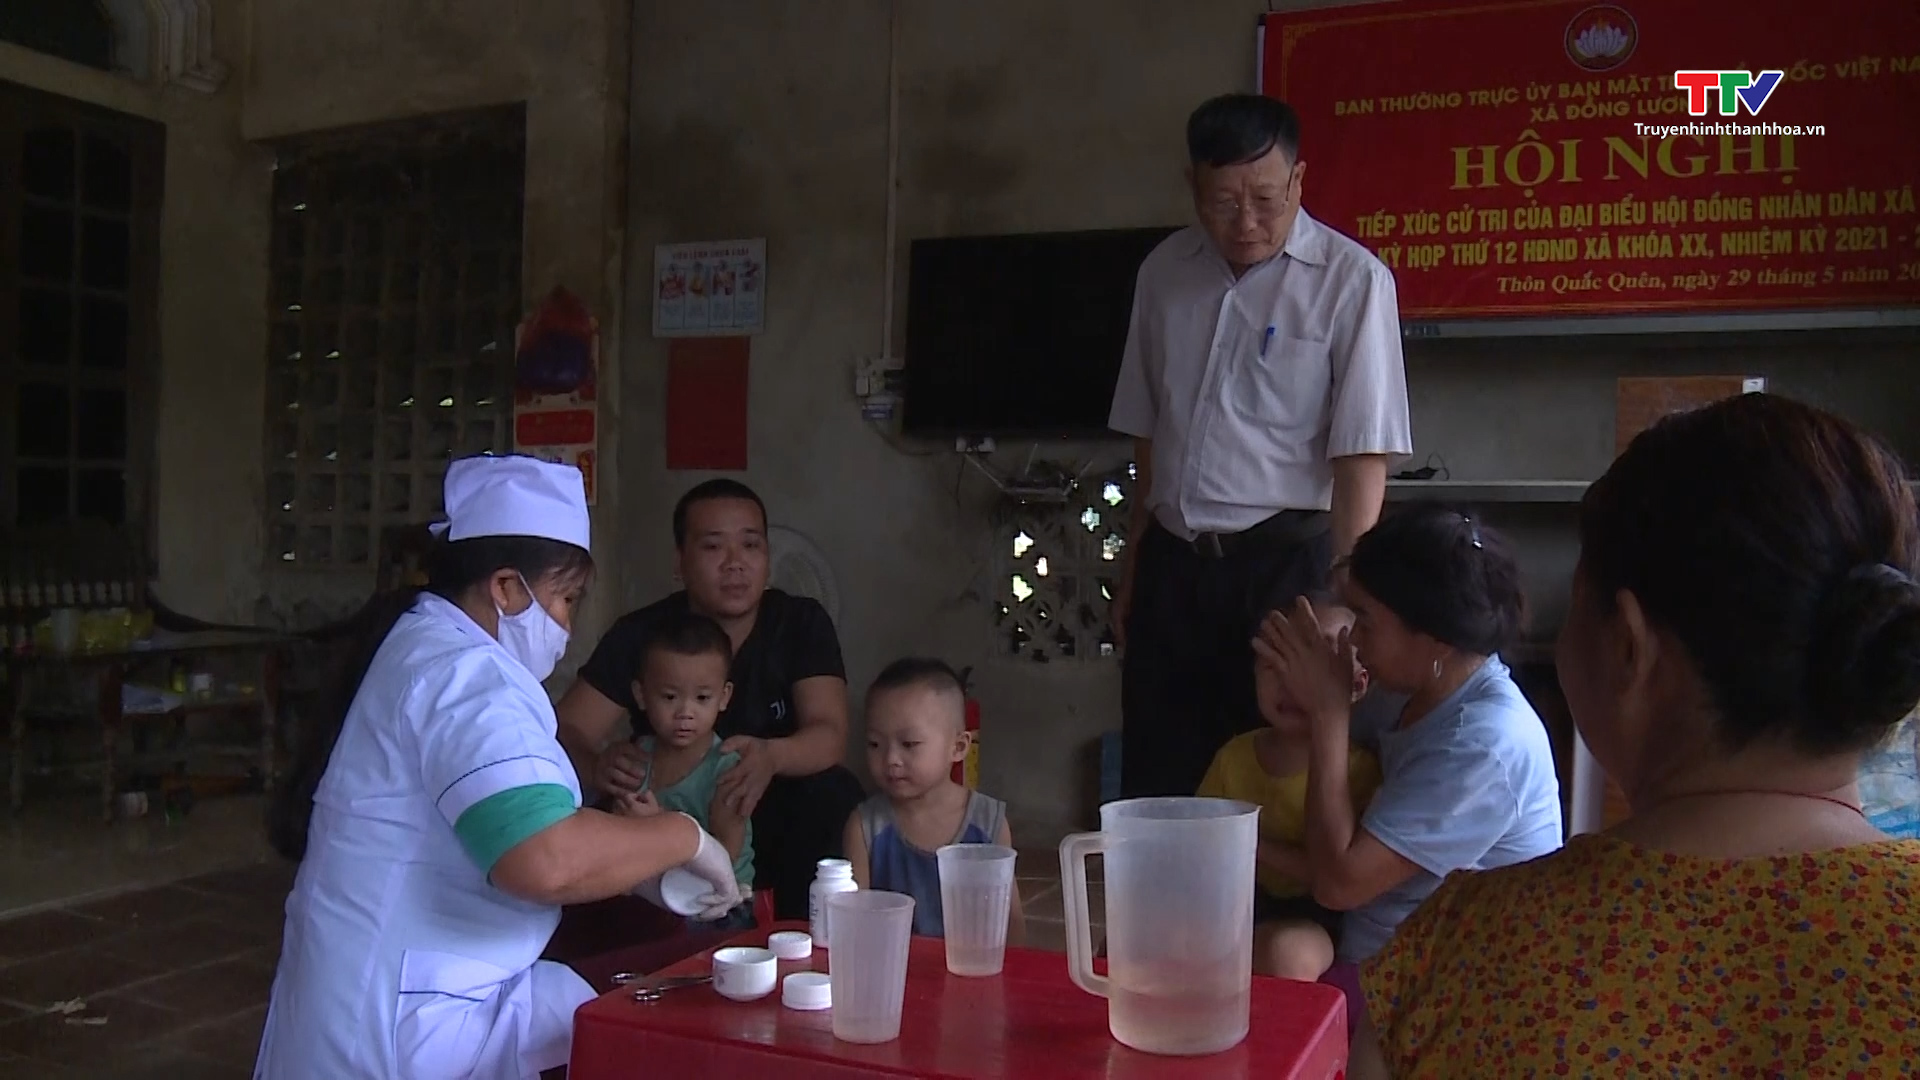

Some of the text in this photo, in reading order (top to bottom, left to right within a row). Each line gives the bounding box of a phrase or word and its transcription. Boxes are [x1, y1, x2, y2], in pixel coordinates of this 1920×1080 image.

[1334, 98, 1374, 116] BAN
[1379, 90, 1462, 113] THƯỜNG
[1468, 86, 1520, 108] TRỰC
[1525, 80, 1552, 102] ỦY
[1558, 79, 1601, 100] BAN
[1607, 73, 1651, 98] MẶT
[1834, 55, 1882, 82] VIỆT
[1529, 102, 1559, 123] XÃ
[1565, 94, 1630, 121] ĐỒNG
[1450, 128, 1800, 198] HỘI NGHỊ
[1356, 208, 1397, 238] TIẾP
[1402, 209, 1441, 237] XÚC
[1446, 203, 1475, 235] CỬ
[1477, 208, 1508, 232] TRI
[1514, 199, 1553, 231] CỦA
[1559, 203, 1593, 232] ĐẠI
[1652, 198, 1687, 228] HỘI
[1759, 189, 1822, 220] NHÂN
[1828, 186, 1876, 217] DÂN
[1883, 184, 1916, 214] XÃ
[1407, 245, 1446, 272] HỌP
[1451, 238, 1490, 267] THỨ
[1494, 241, 1518, 265] 12
[1583, 231, 1612, 261] XÃ
[1617, 229, 1674, 259] KHÓA
[1679, 232, 1714, 260] XX,
[1721, 225, 1792, 261] NHIỆM
[1799, 222, 1828, 254] KỲ
[1835, 225, 1888, 252] 2021
[1497, 275, 1546, 294] Thôn
[1608, 271, 1666, 292] Quên,
[1672, 269, 1721, 292] ngày
[1727, 268, 1752, 286] 29
[1757, 267, 1817, 288] tháng
[1821, 265, 1836, 284] 5
[1841, 265, 1889, 284] năm
